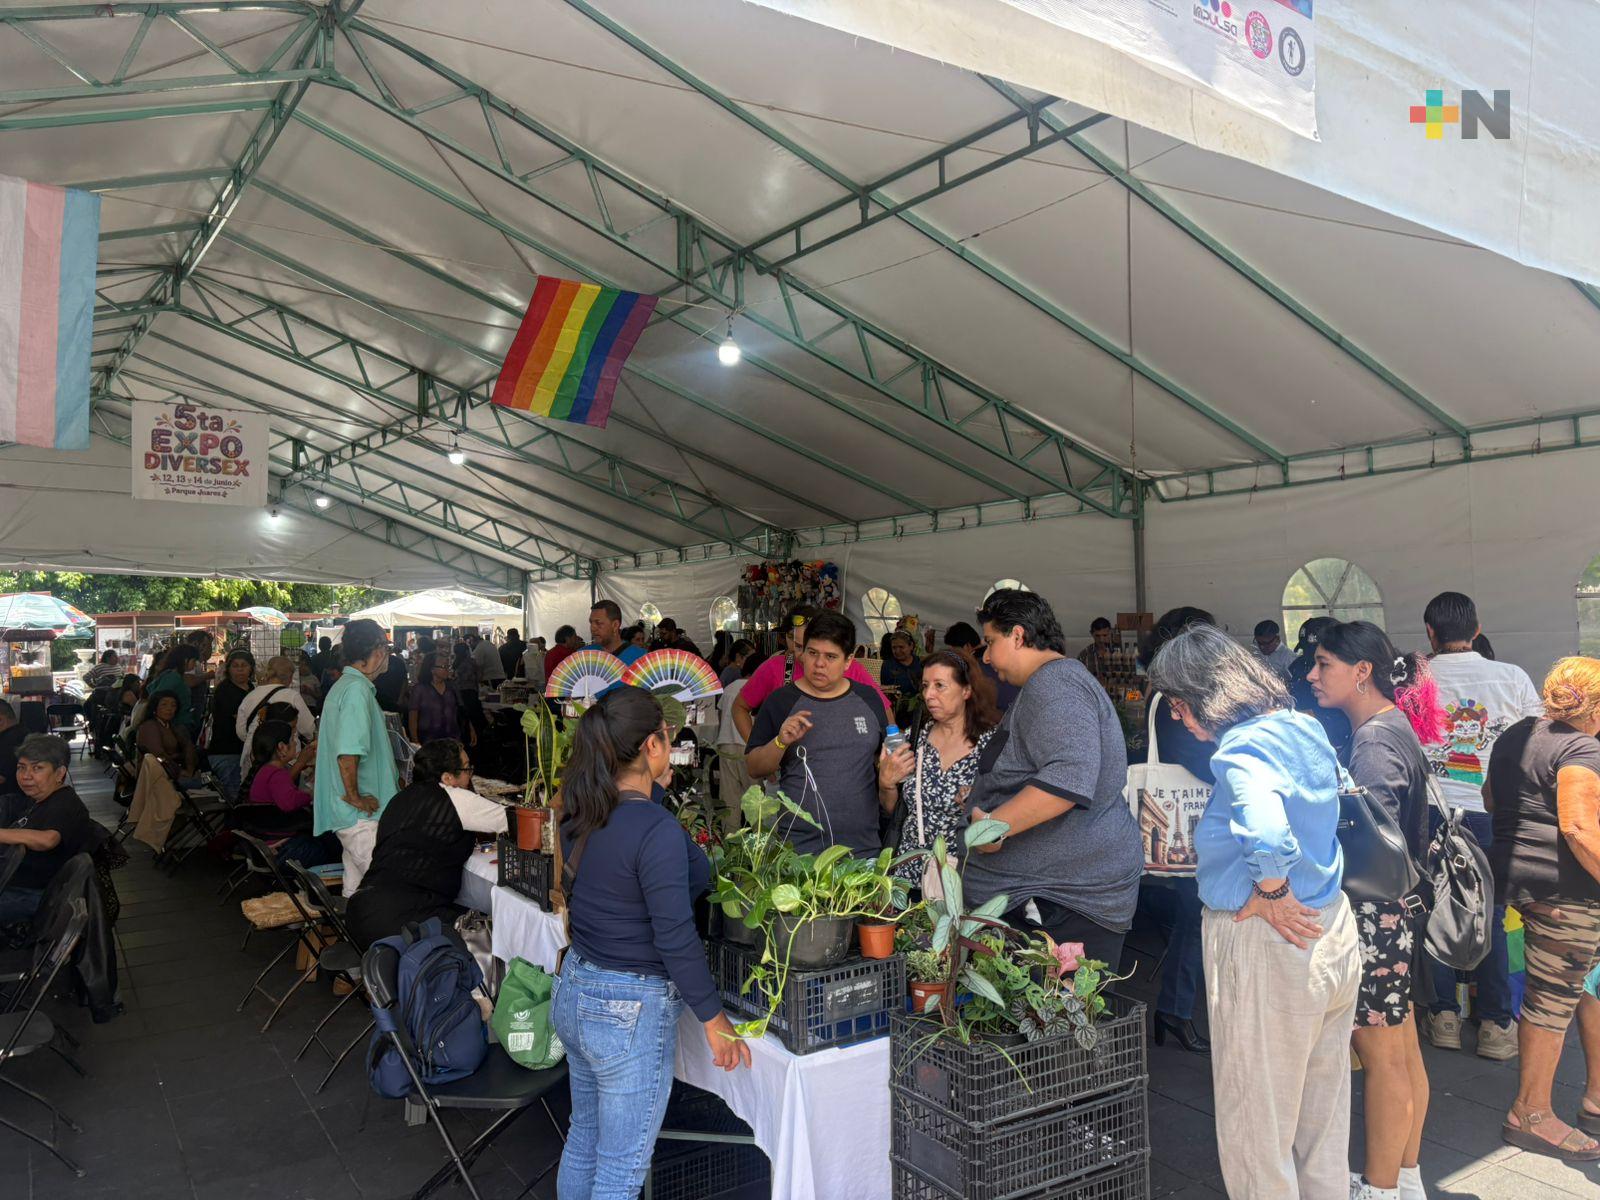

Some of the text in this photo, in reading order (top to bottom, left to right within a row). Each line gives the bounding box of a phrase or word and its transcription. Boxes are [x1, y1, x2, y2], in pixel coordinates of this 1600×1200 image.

[174, 405, 223, 432] 5ta
[151, 428, 243, 459] EXPO
[144, 452, 250, 477] DIVERSEX
[163, 474, 174, 483] 12,
[176, 475, 186, 483] 13
[194, 476, 202, 484] 14
[172, 487, 196, 496] Parque
[1152, 787, 1211, 799] JE T'AIME
[1183, 801, 1206, 812] FRAN
